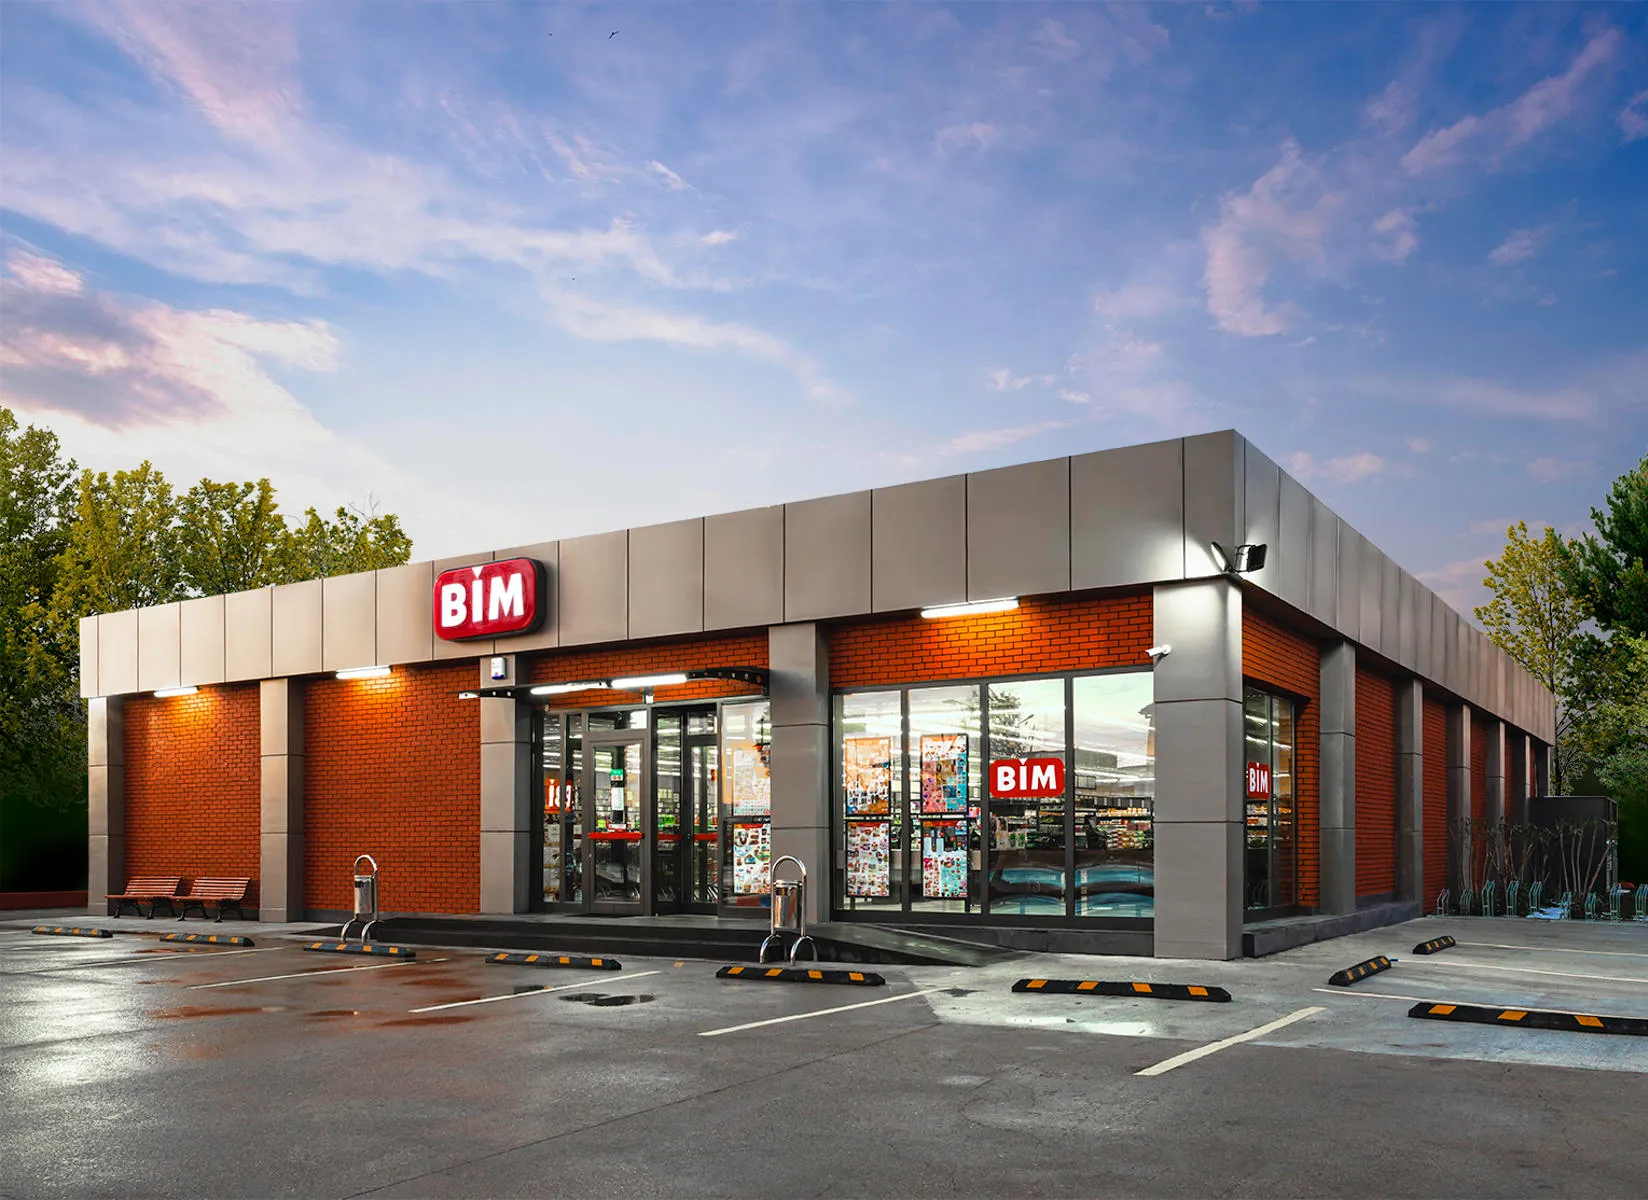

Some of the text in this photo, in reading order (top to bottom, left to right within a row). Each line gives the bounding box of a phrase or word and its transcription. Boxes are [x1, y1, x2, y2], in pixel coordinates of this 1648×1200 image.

[441, 566, 524, 628] BİM
[996, 758, 1058, 791] BİM
[1249, 762, 1268, 793] BİM
